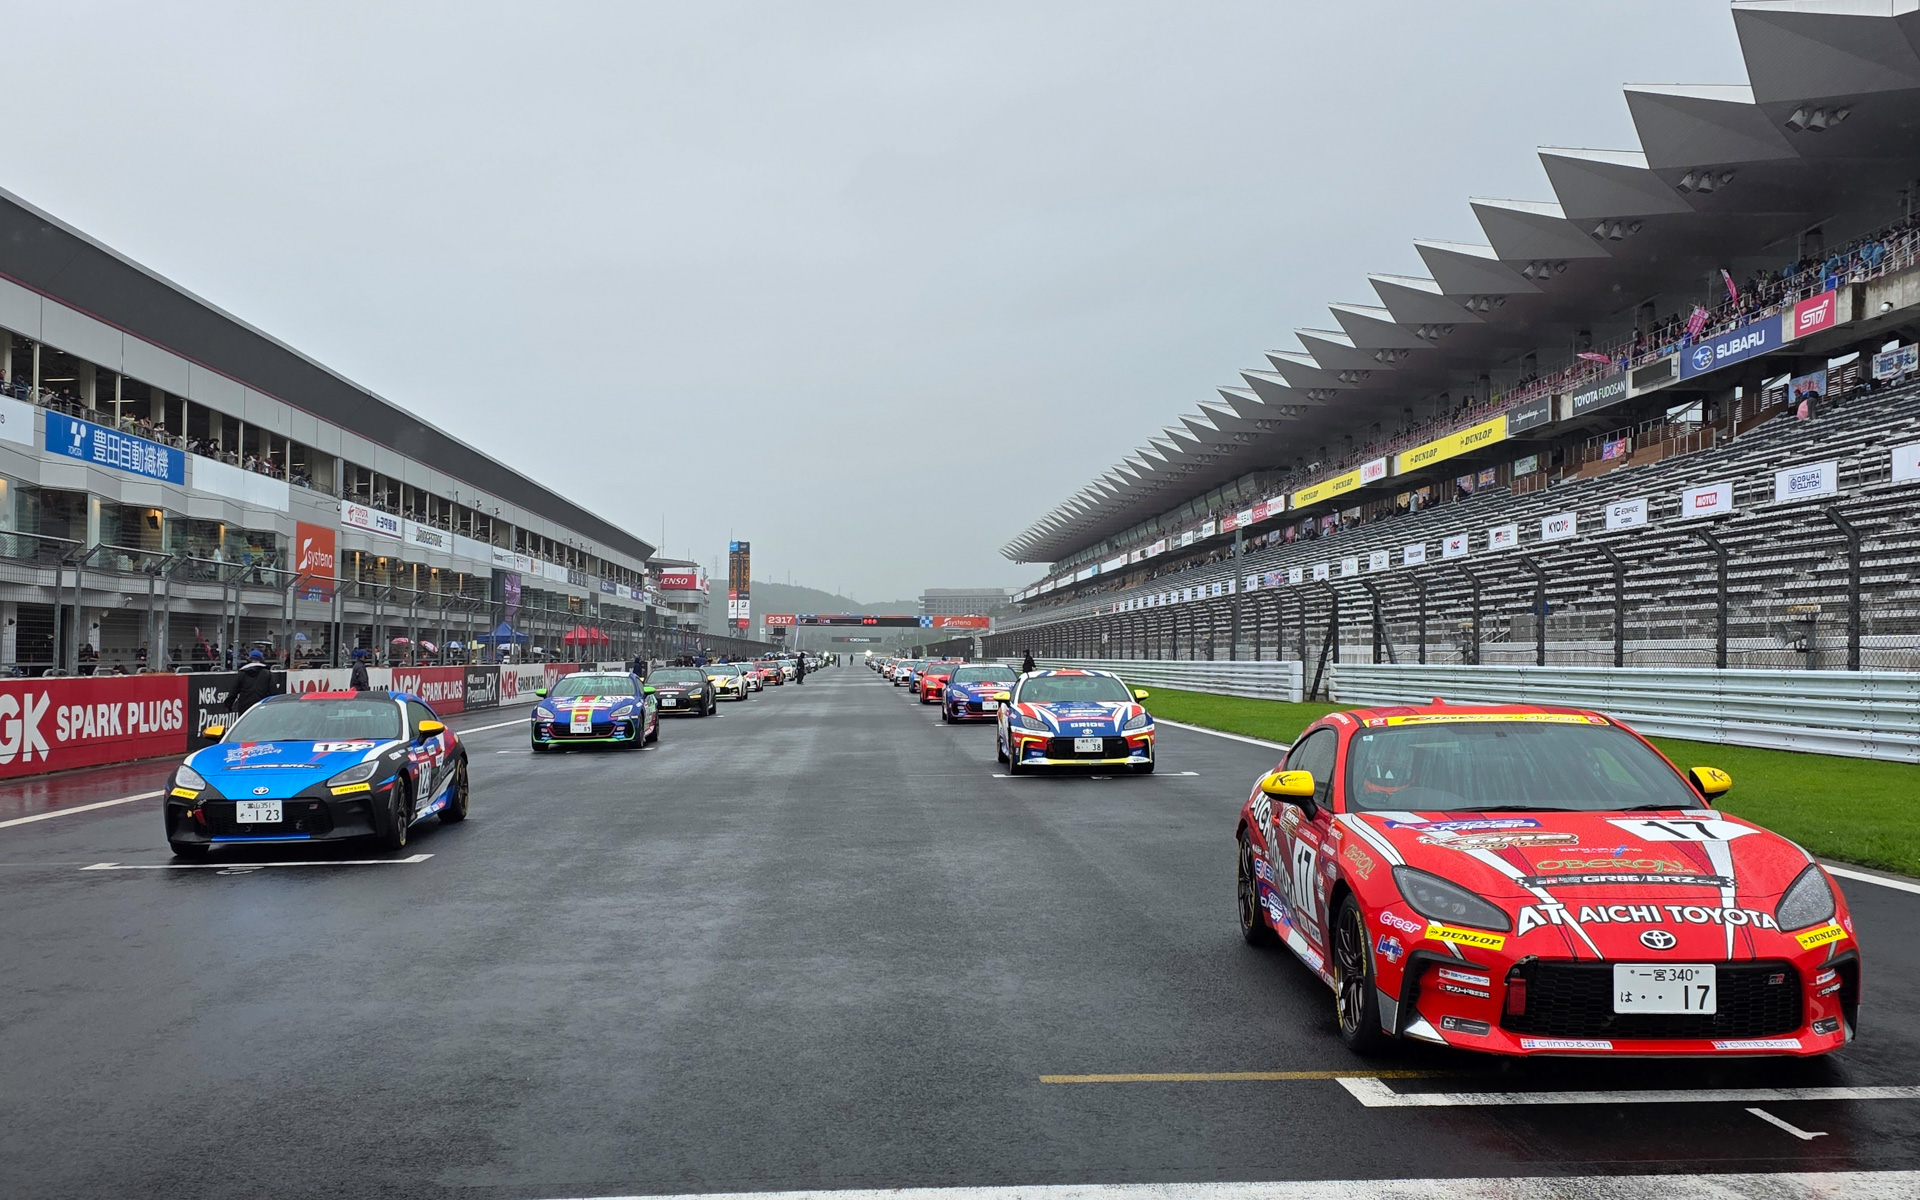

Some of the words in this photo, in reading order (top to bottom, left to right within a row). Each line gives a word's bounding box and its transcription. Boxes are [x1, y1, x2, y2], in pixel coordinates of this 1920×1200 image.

[1716, 329, 1765, 360] SUBARU
[1573, 390, 1599, 408] TOYOTA
[1598, 381, 1626, 399] FUDOSAN
[1464, 428, 1493, 446] DUNLOP
[92, 429, 169, 479] 豊田自動織機
[1414, 448, 1438, 463] DUNLOP
[1335, 478, 1353, 491] DUNLOP
[1797, 474, 1820, 483] OGURA
[1797, 480, 1820, 490] CLUTCH
[1696, 493, 1717, 506] MOTUL
[1621, 505, 1639, 515] EDIFICE
[767, 616, 793, 624] 2317
[421, 682, 443, 702] SPARK
[443, 680, 463, 700] PLUGS
[485, 673, 498, 701] RX
[501, 670, 518, 700] NGK
[518, 675, 531, 693] SPARK
[199, 687, 216, 705] NGK
[56, 702, 122, 742] SPARK
[127, 698, 183, 735] PLUGS
[1092, 743, 1102, 751] 38
[1640, 820, 1720, 839] 17
[1536, 857, 1684, 873] OBERON
[1297, 845, 1312, 913] 17
[1380, 911, 1421, 933] Creer
[1579, 904, 1664, 923] AICHI
[1664, 904, 1782, 933] TOYOTA
[1439, 930, 1501, 946] DUNLOP
[1807, 927, 1842, 944] DUNLOP
[1620, 991, 1633, 1004] は
[1683, 984, 1711, 1010] 17
[1538, 1040, 1611, 1048] climb&aim
[1729, 1039, 1799, 1049] climb&aim
